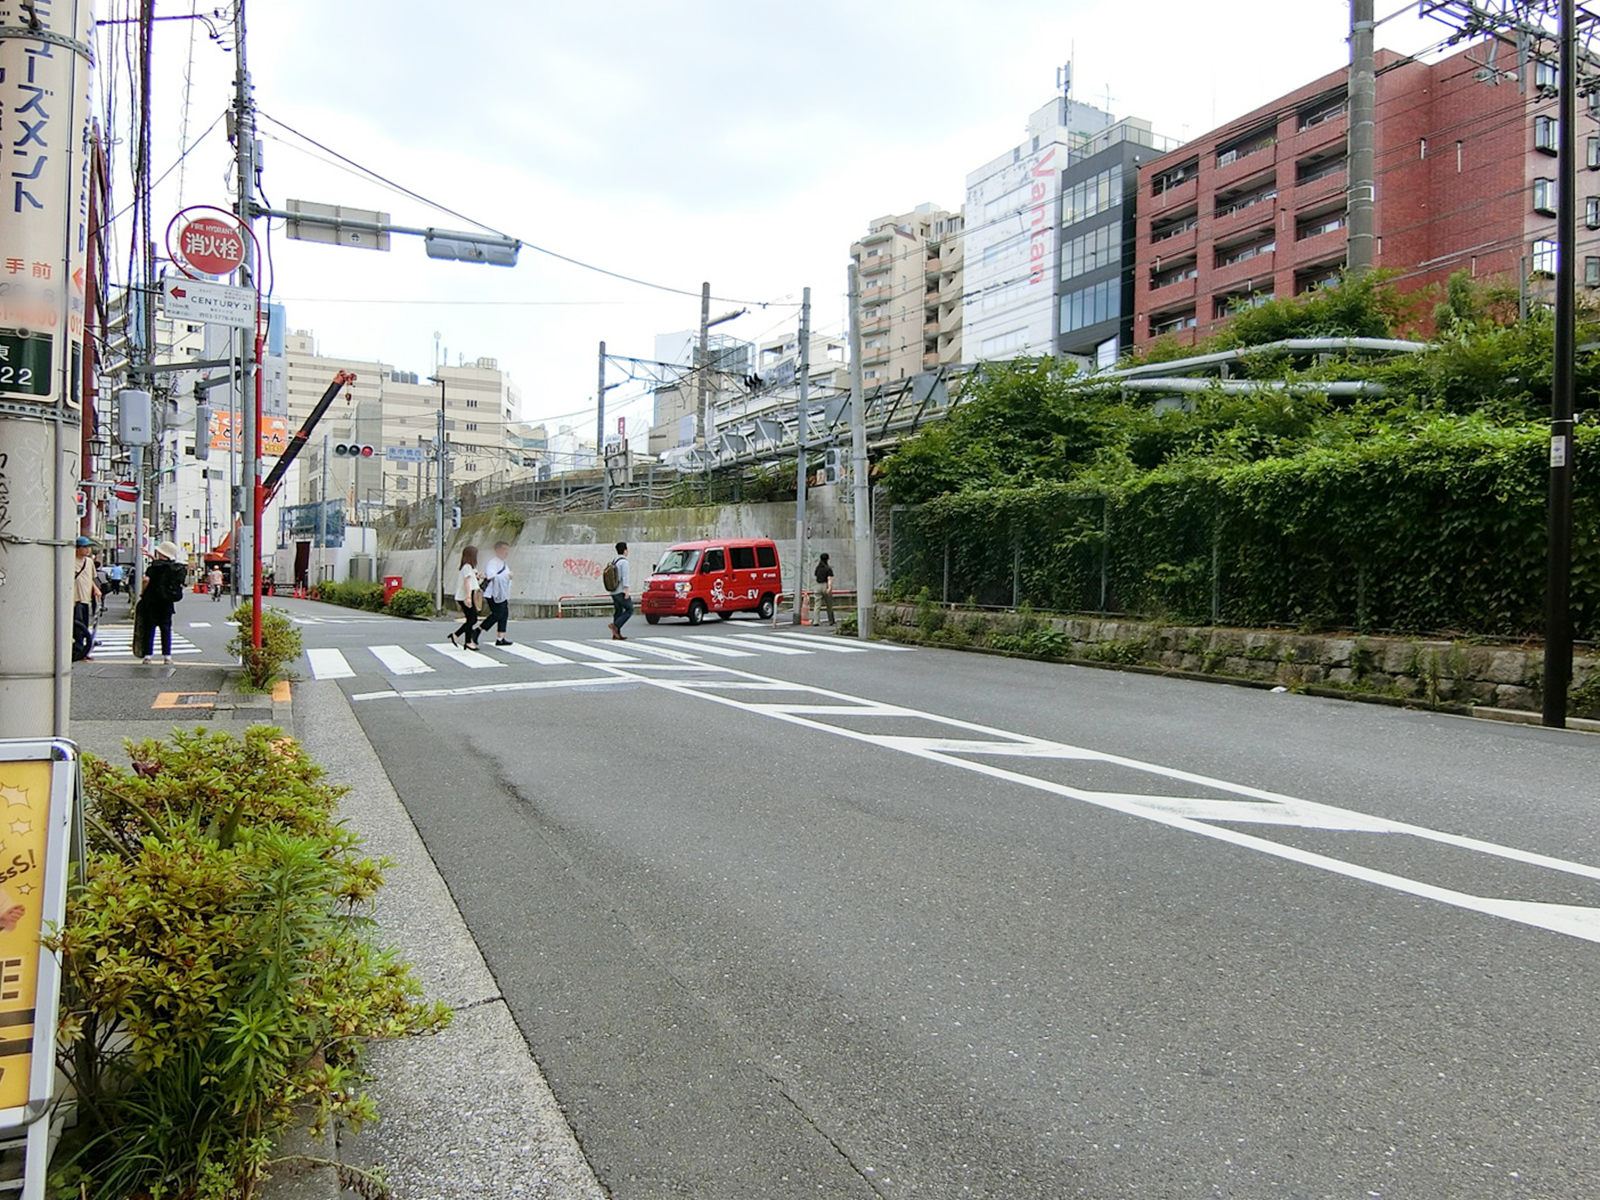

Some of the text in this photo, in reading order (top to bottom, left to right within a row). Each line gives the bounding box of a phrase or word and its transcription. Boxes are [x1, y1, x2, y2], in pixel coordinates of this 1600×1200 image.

[1029, 147, 1056, 285] Vantan
[190, 222, 234, 235] FIRE HYDRANT
[185, 232, 239, 261] 消火栓
[5, 258, 52, 280] 手前
[191, 296, 252, 311] CENTURY 21
[747, 589, 759, 599] EV
